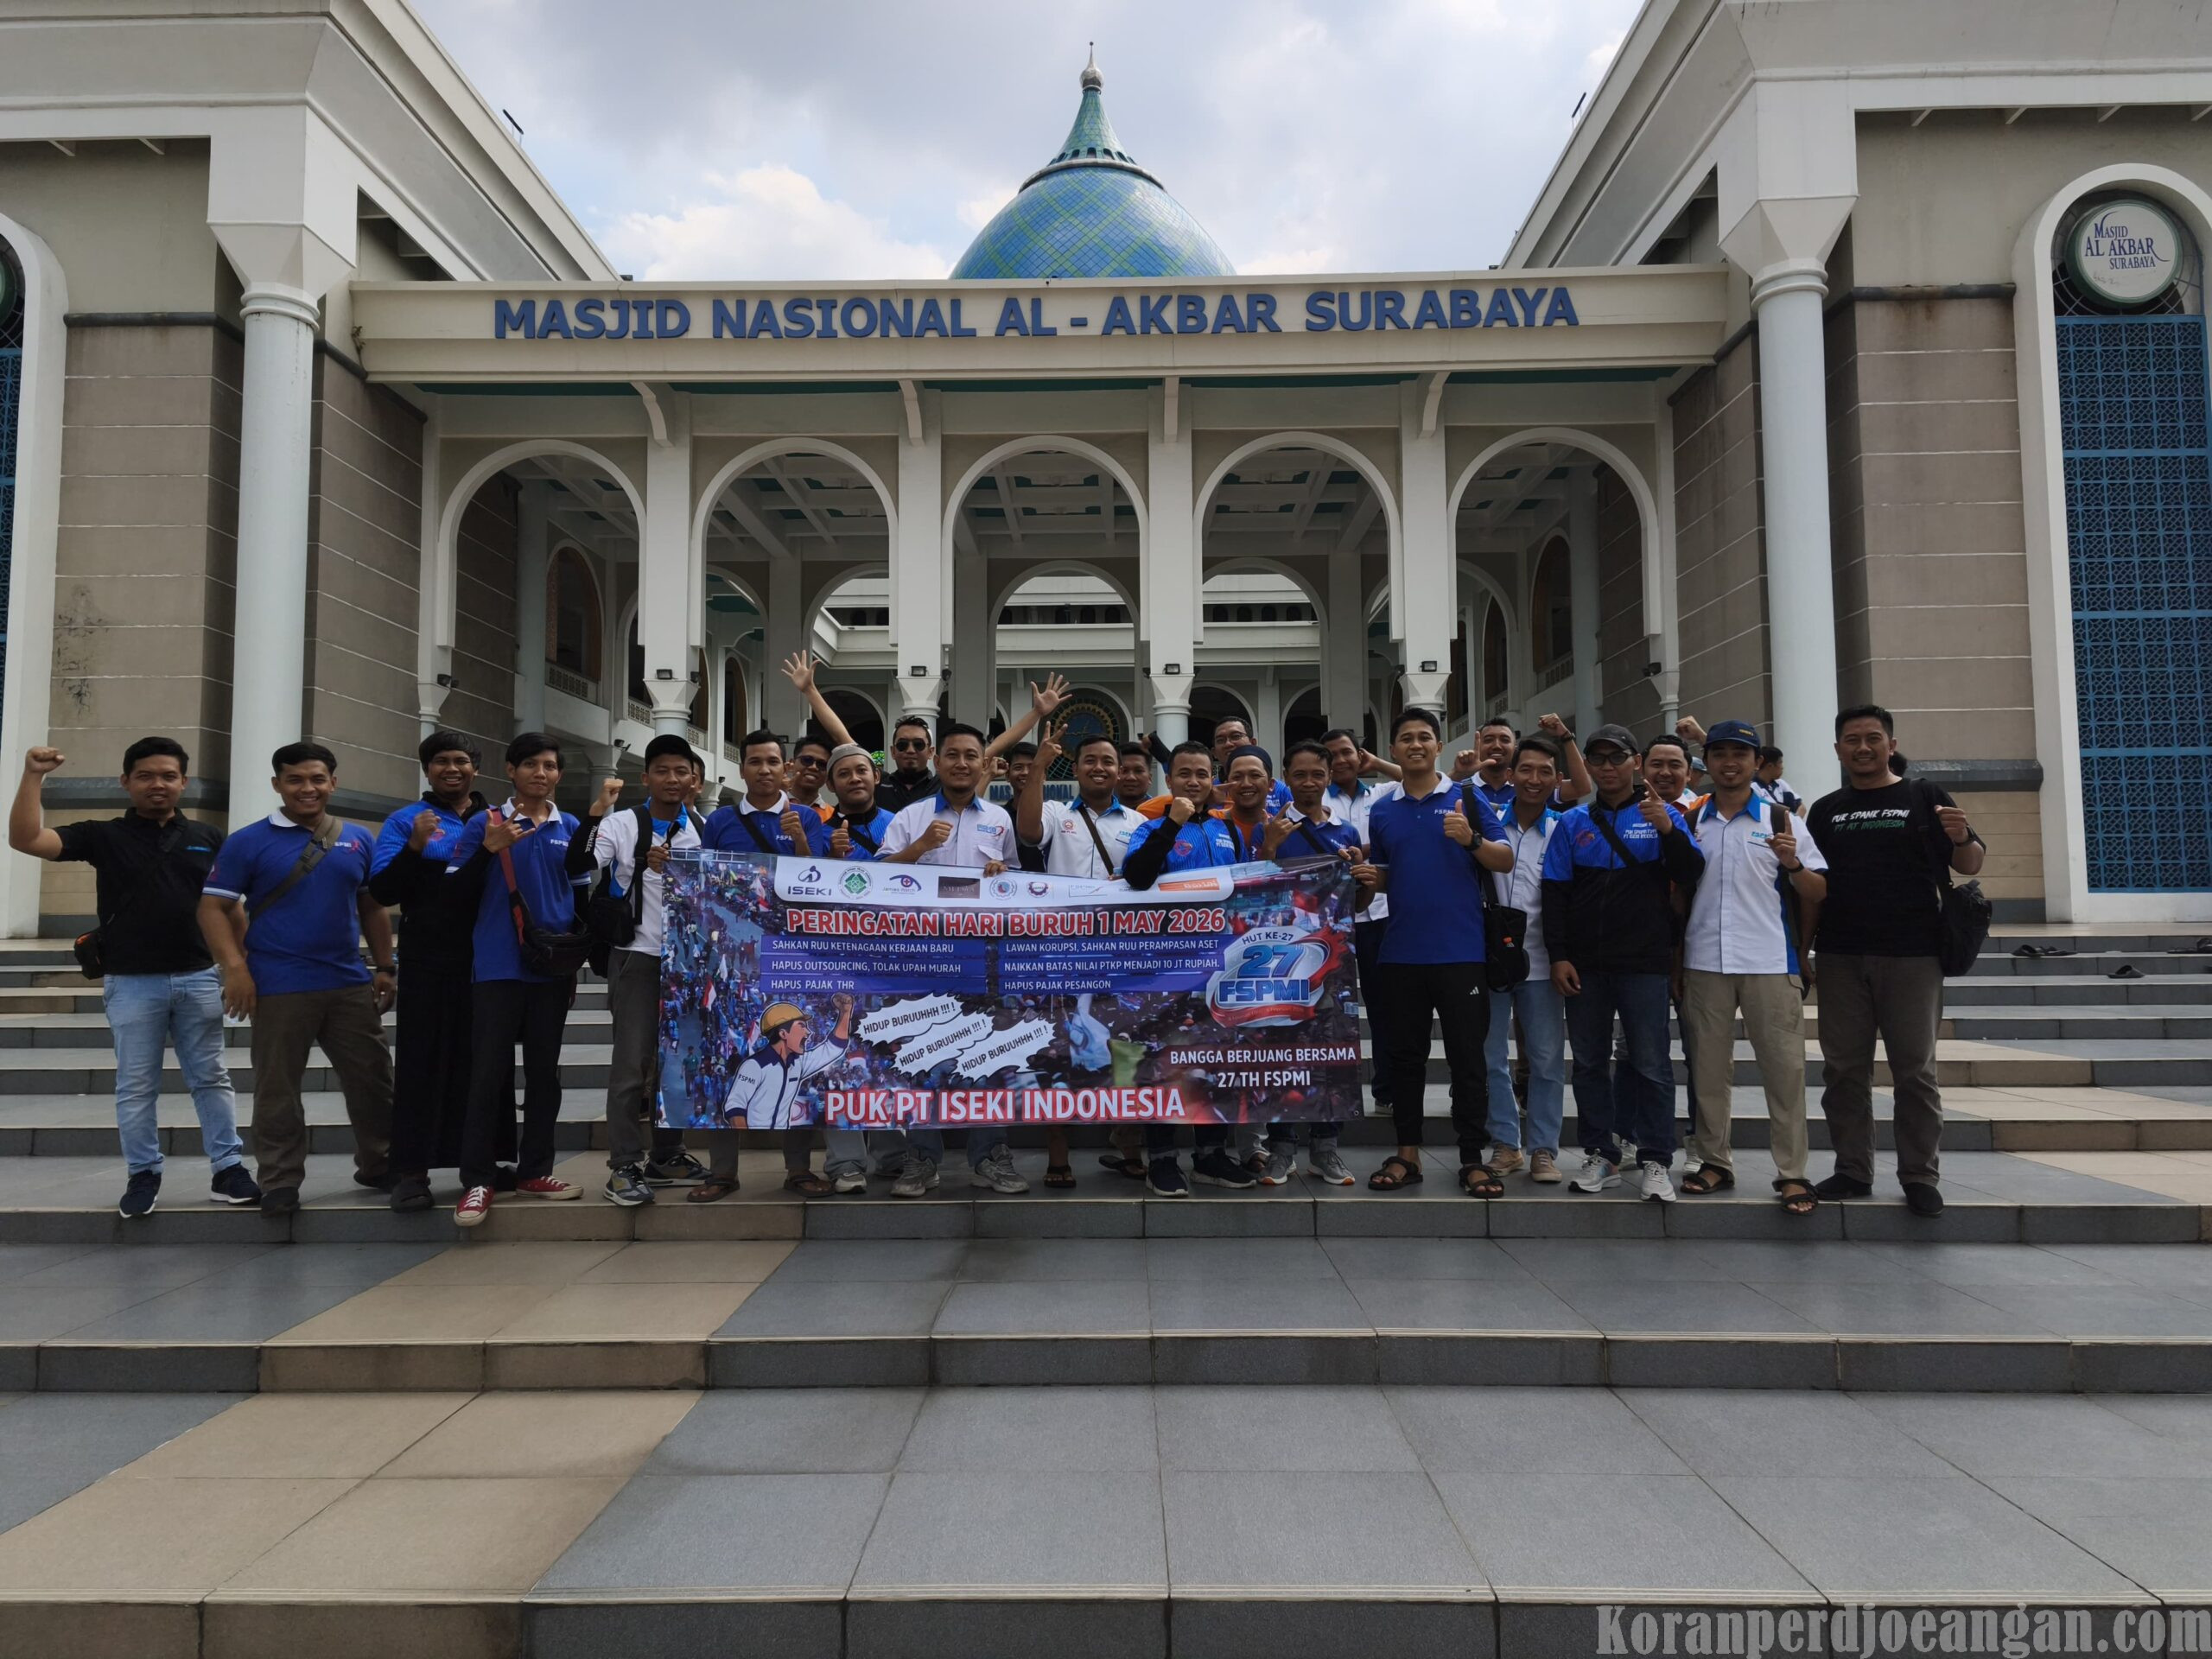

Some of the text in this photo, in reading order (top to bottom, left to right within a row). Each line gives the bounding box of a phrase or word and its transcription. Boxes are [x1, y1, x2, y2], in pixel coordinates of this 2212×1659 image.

[2094, 216, 2128, 240] MASJID
[2085, 236, 2160, 258] AL AKBAR
[2109, 257, 2156, 270] SURABAYA
[495, 299, 690, 339] MASJID
[712, 297, 976, 339] NASIONAL
[995, 297, 1057, 337] AL
[1102, 294, 1282, 335] AKBAR
[1306, 286, 1580, 332] SURABAYA
[989, 785, 1012, 800] MAS
[1882, 810, 1910, 818] FSPMI
[788, 886, 831, 896] ISEKI
[787, 908, 1225, 936] PERINGATAN HARI BURUH 1 MAY 2026
[1242, 931, 1294, 944] HUT KE-27
[772, 940, 954, 953] SAHKAN RUU KETENAGAAN KERJAAN BARU
[1006, 940, 1219, 953] LAWAN KORUPSI, SAHKAN RUU PERAMPASAN ASET
[772, 961, 961, 973] HAPUS OUTSOURCING, TOLAK UPAH MURAH
[1005, 959, 1220, 971] NAIKKAN BATAS NILAI PTKP MENJADI 10 JT RUPIAH.
[772, 980, 854, 989] HAPUS PAJAK THR
[1005, 980, 1111, 990] HAPUS PAJAK PESANGON
[1219, 979, 1310, 1002] FSPMI
[863, 1019, 890, 1034] HIDUP
[892, 1008, 939, 1026] BURUUHHH
[941, 1004, 950, 1014] !!!
[899, 1049, 925, 1067] HIDUP
[926, 1027, 971, 1054] BURUUHHH
[972, 1022, 982, 1033] !!!
[962, 1054, 987, 1072] HIDUP
[988, 1033, 1033, 1059] BURUUHHH
[1033, 1028, 1043, 1039] !!!
[1171, 1047, 1356, 1064] BANGGA BERJUANG BERSAMA
[738, 1074, 756, 1084] FSPMI
[1217, 1071, 1311, 1088] 27 TH FSPMI
[826, 1091, 887, 1122] PUK
[897, 1090, 932, 1122] PT
[940, 1090, 1014, 1121] ISEKI
[1024, 1088, 1186, 1120] INDONESIA
